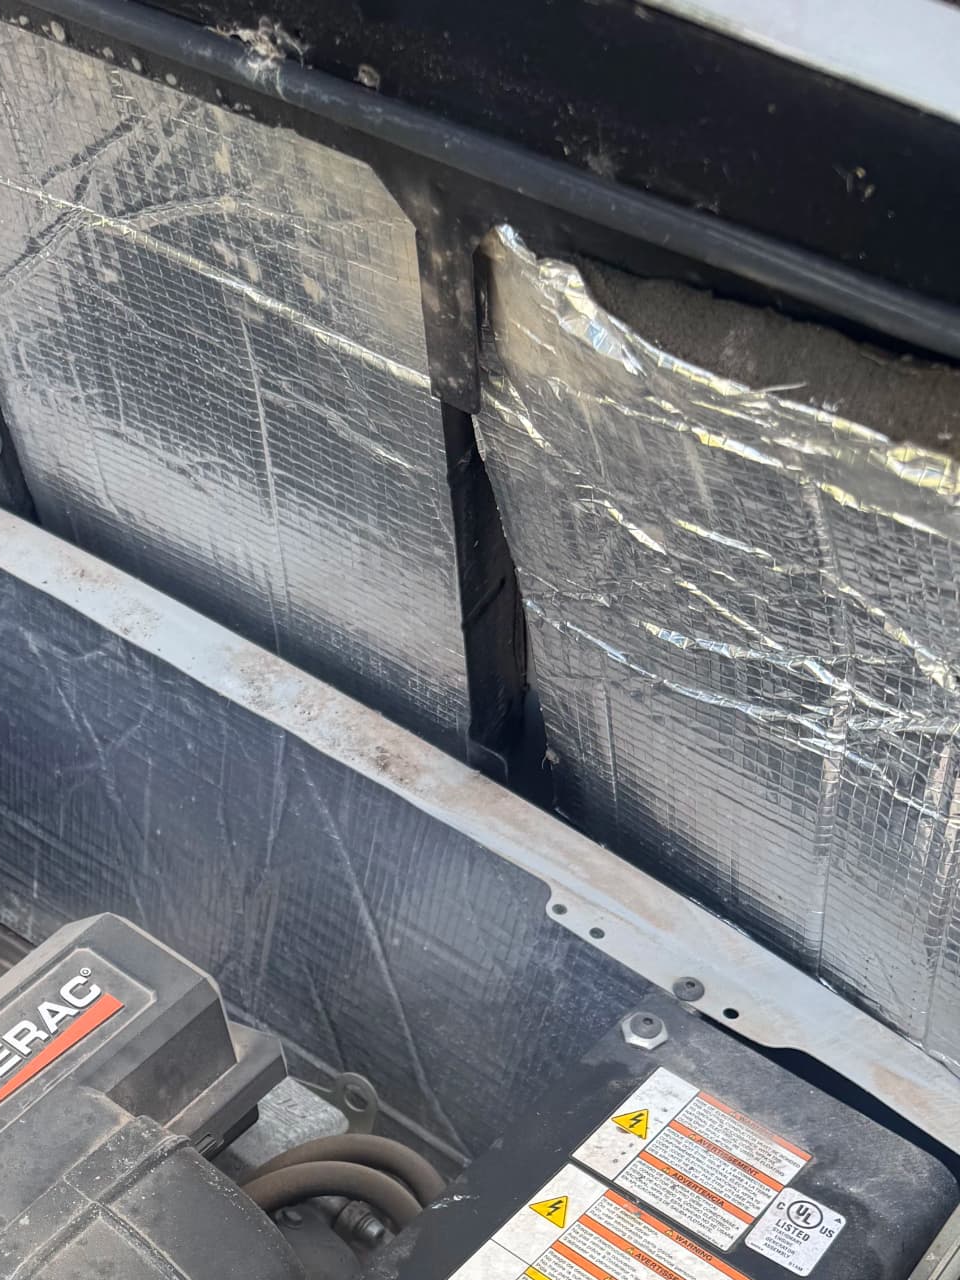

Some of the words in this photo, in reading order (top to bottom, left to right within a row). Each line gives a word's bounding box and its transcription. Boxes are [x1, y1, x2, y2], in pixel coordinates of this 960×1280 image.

[696, 1137, 760, 1177] AVERTISSEMENT
[670, 1171, 726, 1207] ADVERTENCIA
[774, 1218, 811, 1242] LISTED
[791, 1203, 818, 1225] UL
[818, 1224, 835, 1239] US
[673, 1234, 714, 1261] WARNING
